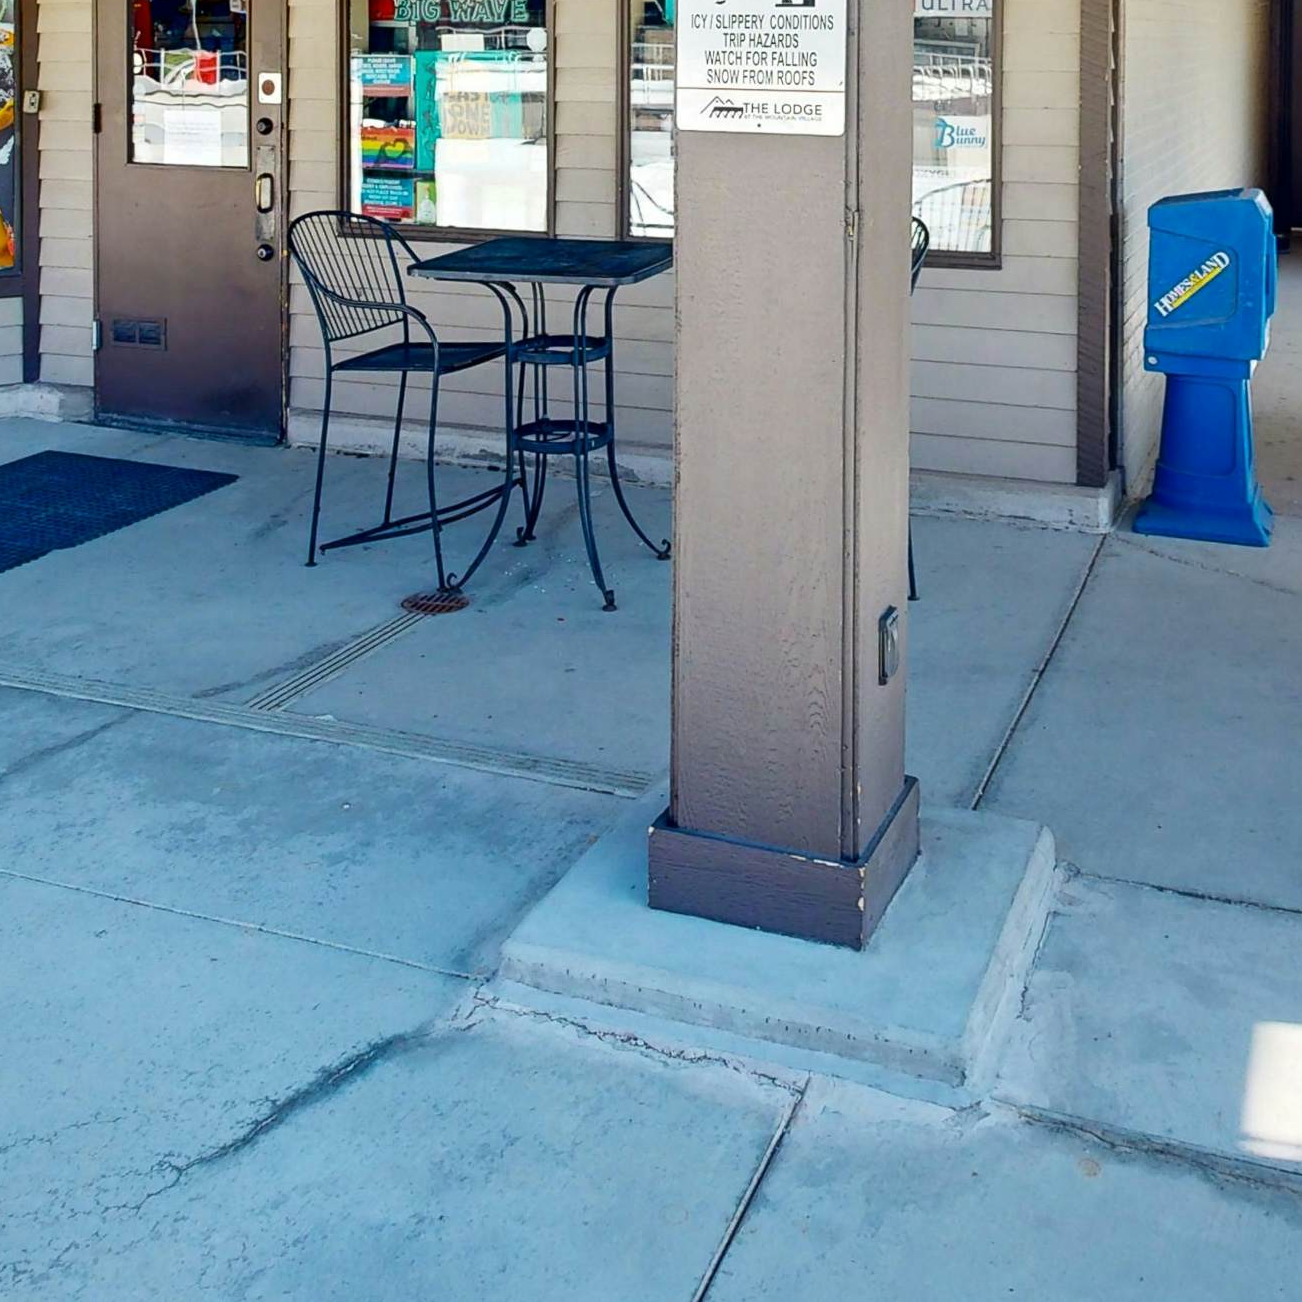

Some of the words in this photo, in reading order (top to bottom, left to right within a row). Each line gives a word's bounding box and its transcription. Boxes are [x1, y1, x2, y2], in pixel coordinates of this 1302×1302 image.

[691, 14, 708, 29] ICY
[715, 14, 765, 30] SLIPPERY
[769, 14, 834, 30] CONDITIONS
[723, 33, 746, 48] TRIP
[749, 33, 799, 49] HAZARDS
[704, 50, 742, 65] WATCH
[746, 51, 768, 66] FOR
[771, 51, 818, 67] FALLING
[706, 69, 739, 84] SNOW
[742, 69, 773, 85] FROM
[777, 70, 815, 86] ROOFS
[743, 102, 769, 114] THE
[774, 103, 823, 115] LODGE
